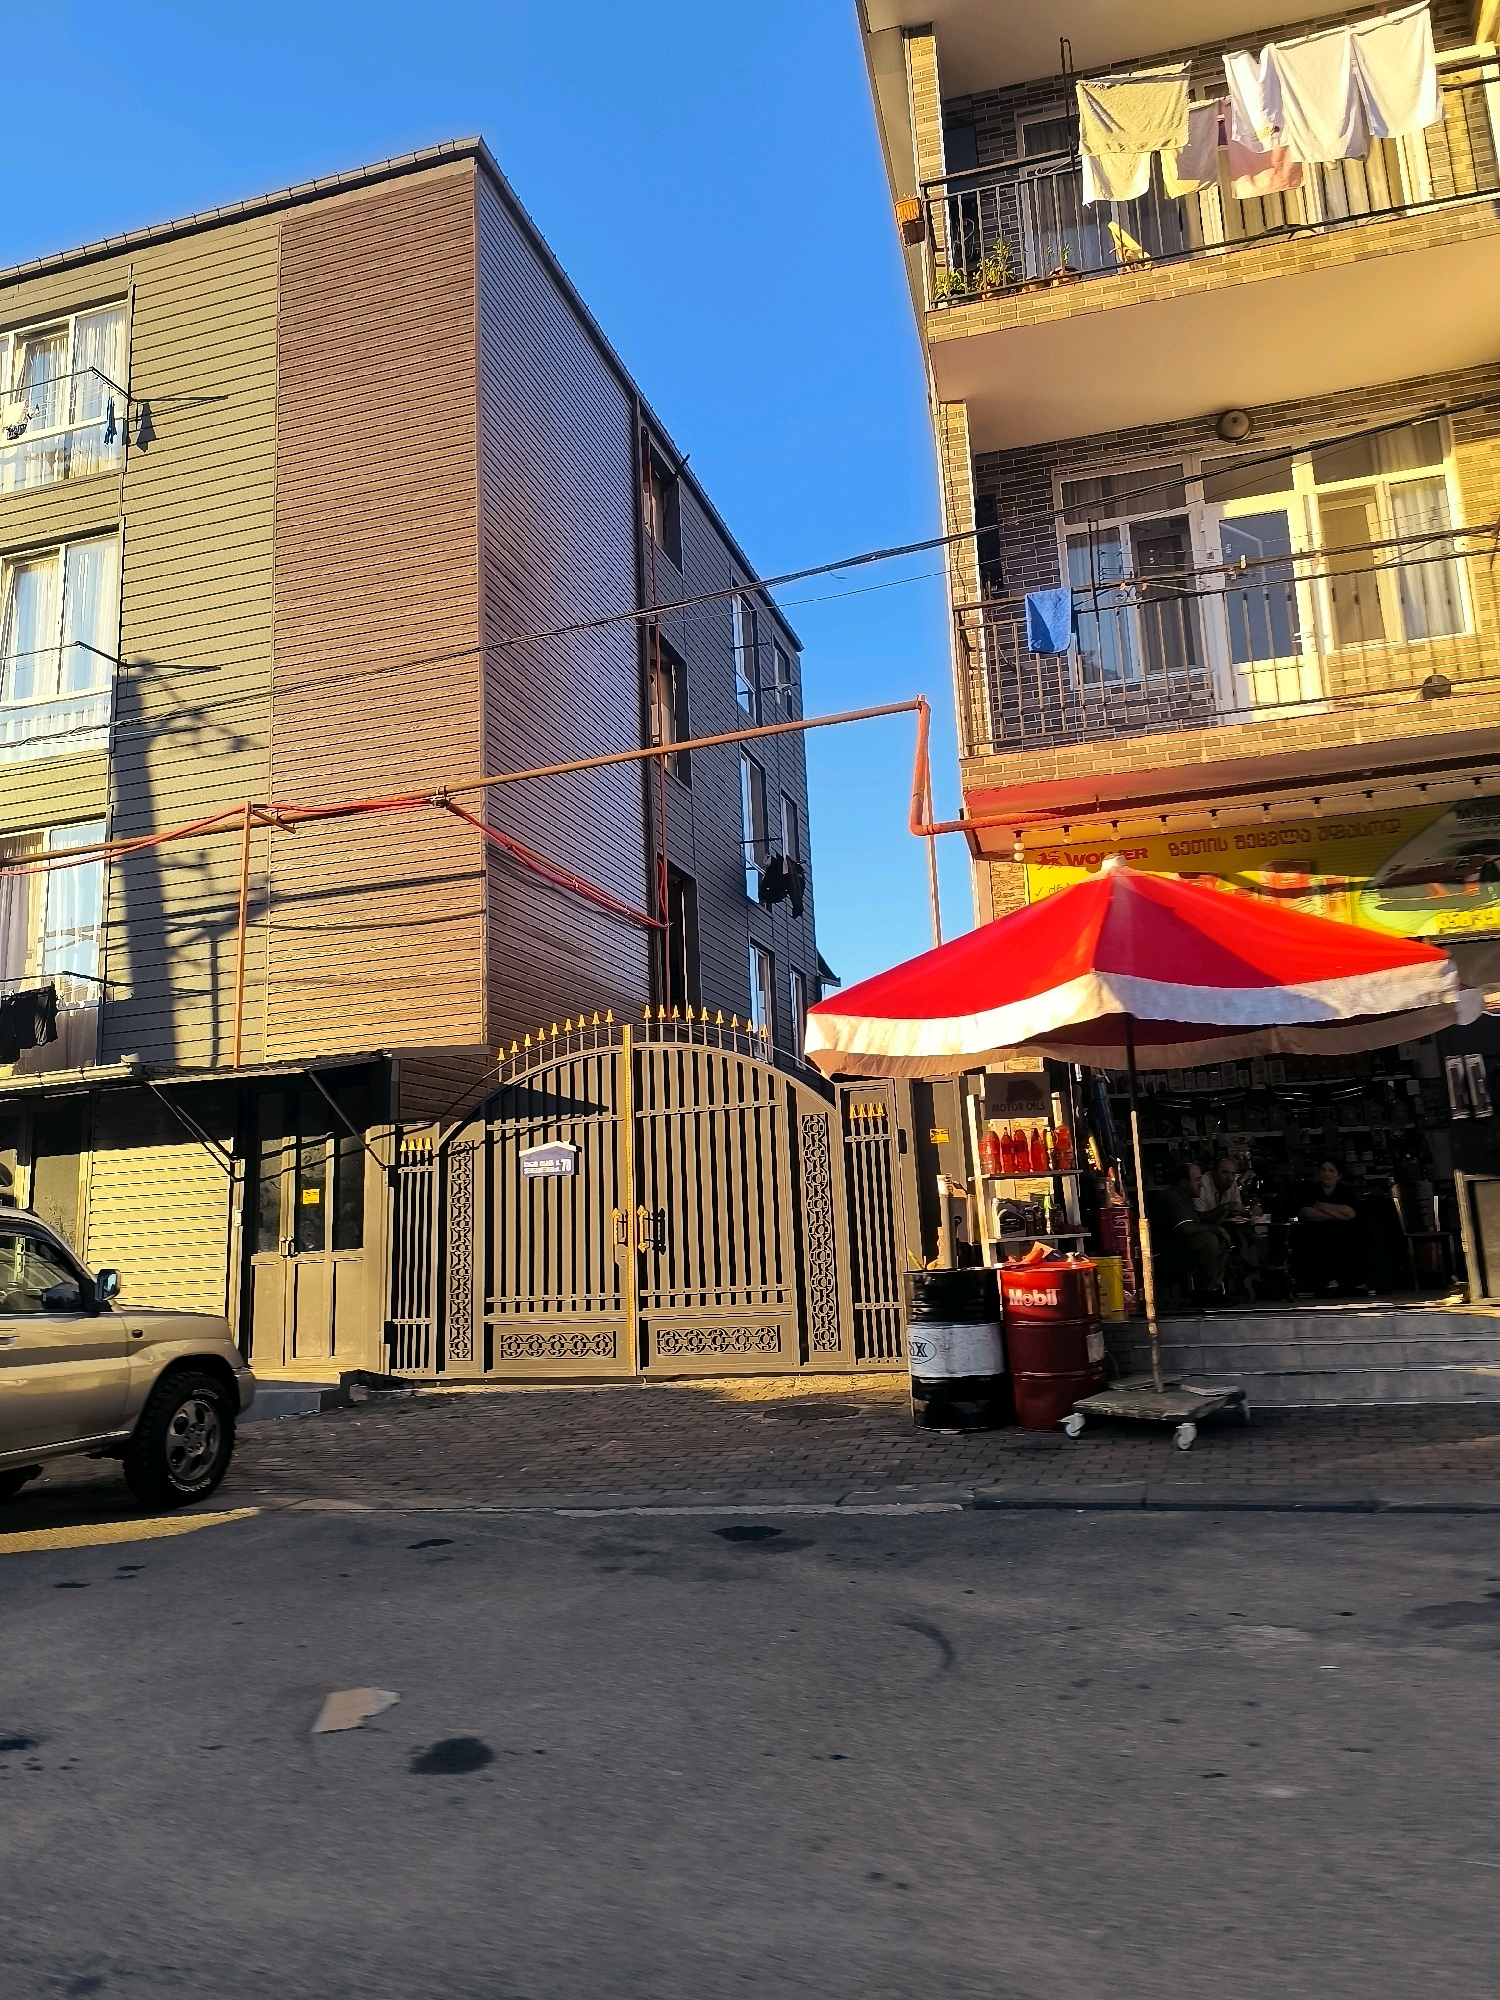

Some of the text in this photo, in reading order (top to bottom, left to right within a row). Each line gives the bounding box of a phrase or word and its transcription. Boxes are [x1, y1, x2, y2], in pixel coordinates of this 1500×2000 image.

[1064, 848, 1149, 867] WOER
[992, 1101, 1046, 1112] MOTOR OILS
[1008, 1288, 1060, 1307] Mobil
